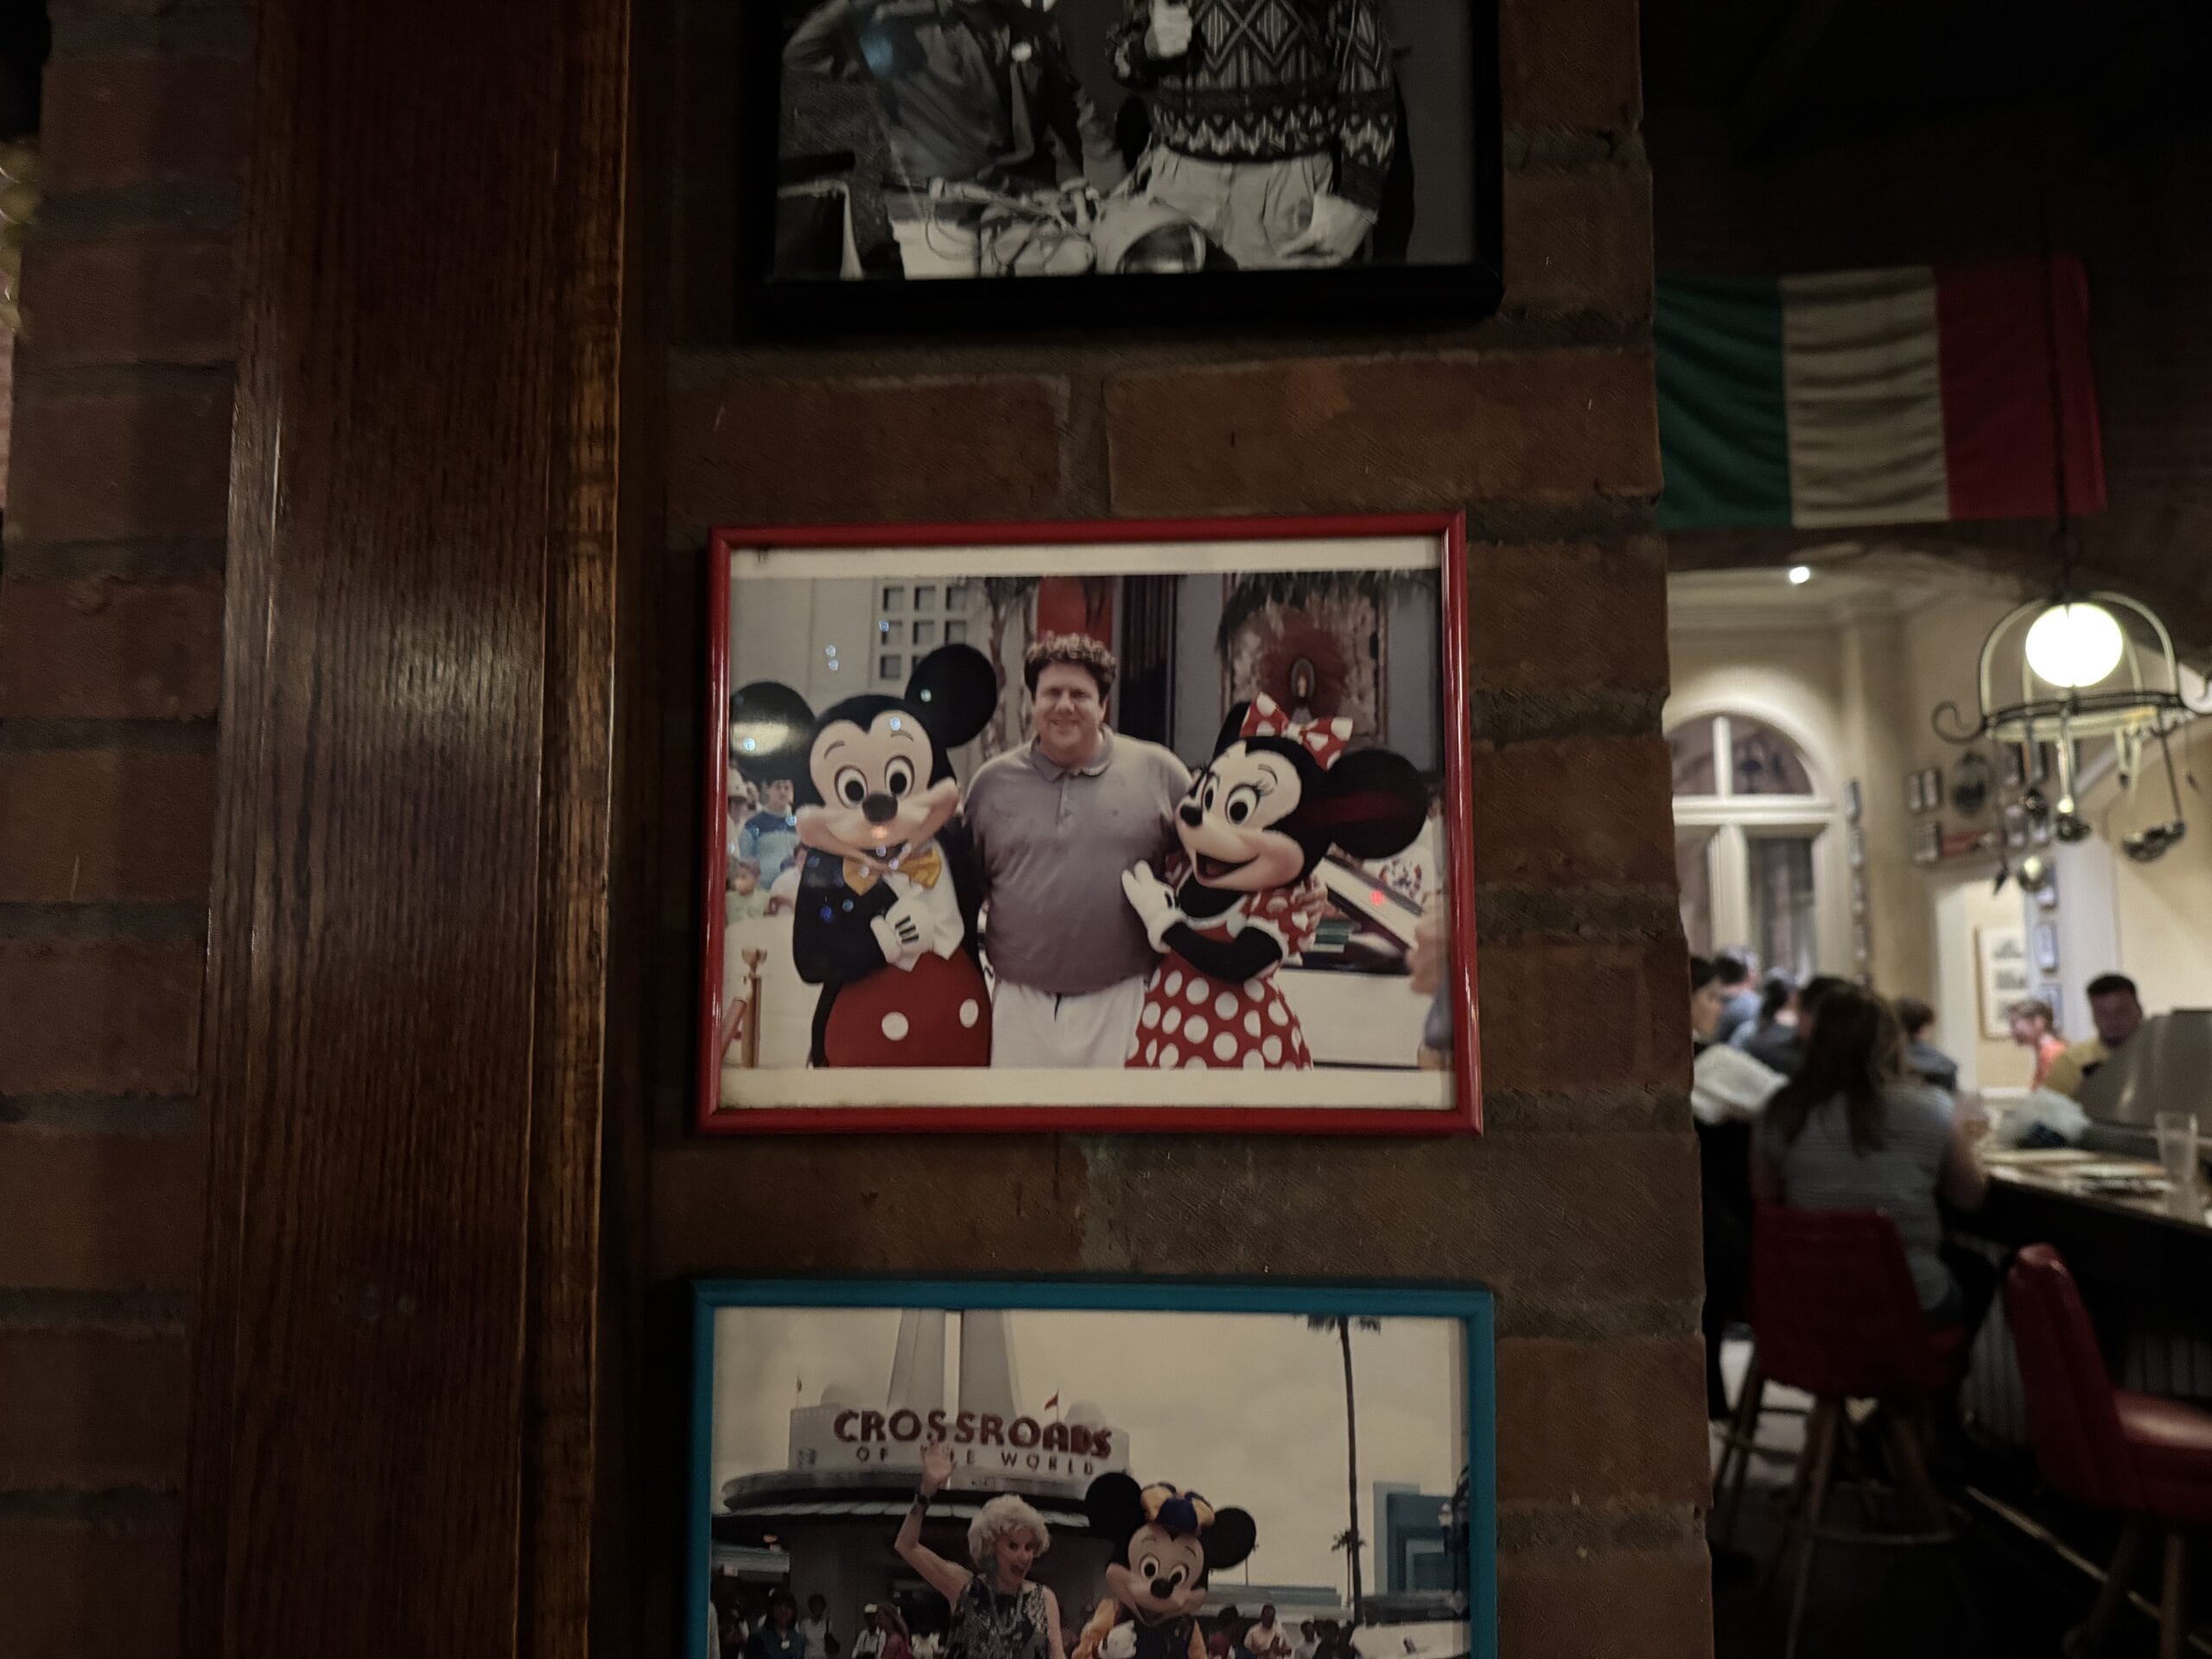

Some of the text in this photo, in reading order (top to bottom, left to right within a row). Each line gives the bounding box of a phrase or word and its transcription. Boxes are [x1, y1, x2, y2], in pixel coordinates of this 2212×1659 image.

[834, 1408, 1112, 1459] CROSSROADS
[856, 1446, 1094, 1475] OF WORLD
